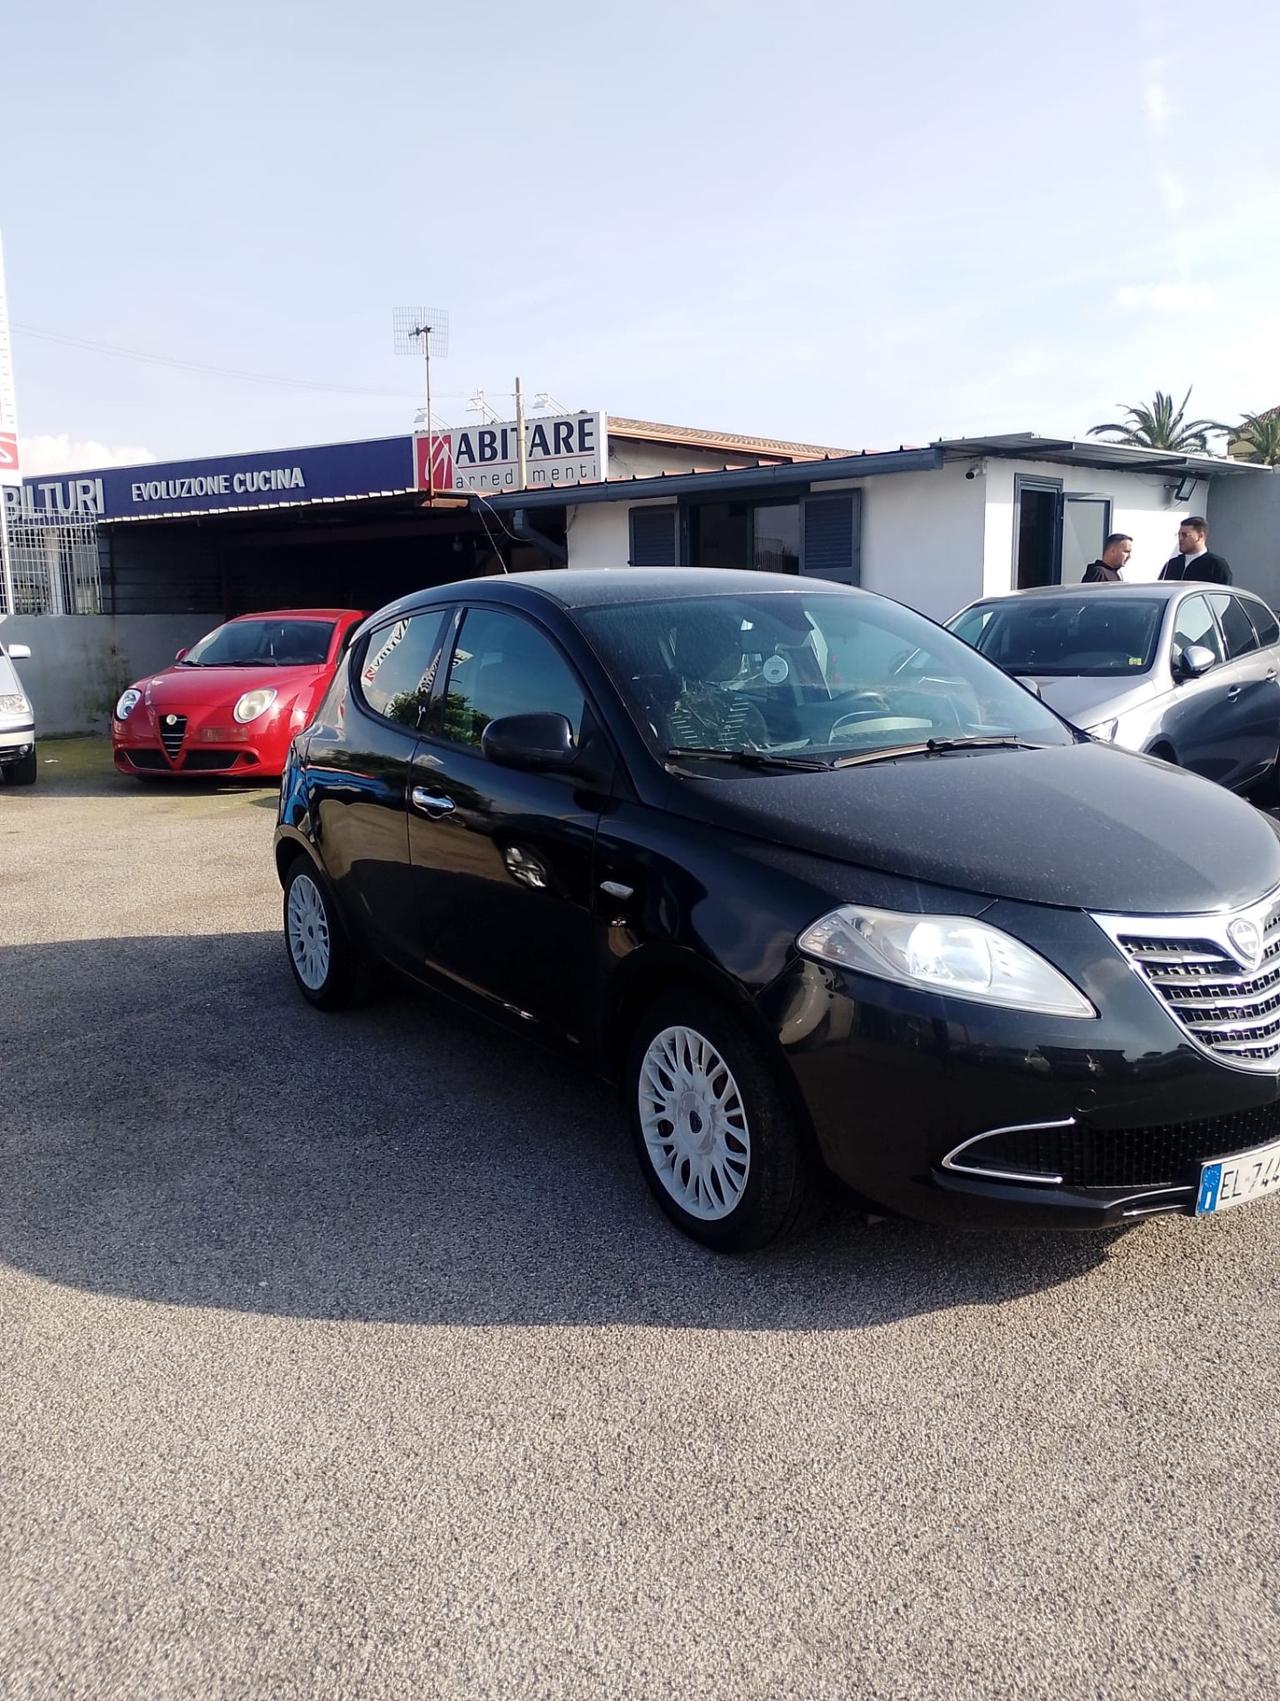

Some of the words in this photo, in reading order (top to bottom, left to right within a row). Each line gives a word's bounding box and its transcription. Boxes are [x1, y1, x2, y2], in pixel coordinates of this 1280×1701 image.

[131, 475, 230, 502] EVOLUZIONE
[233, 467, 305, 493] CUCINA
[456, 461, 596, 489] arredmenti
